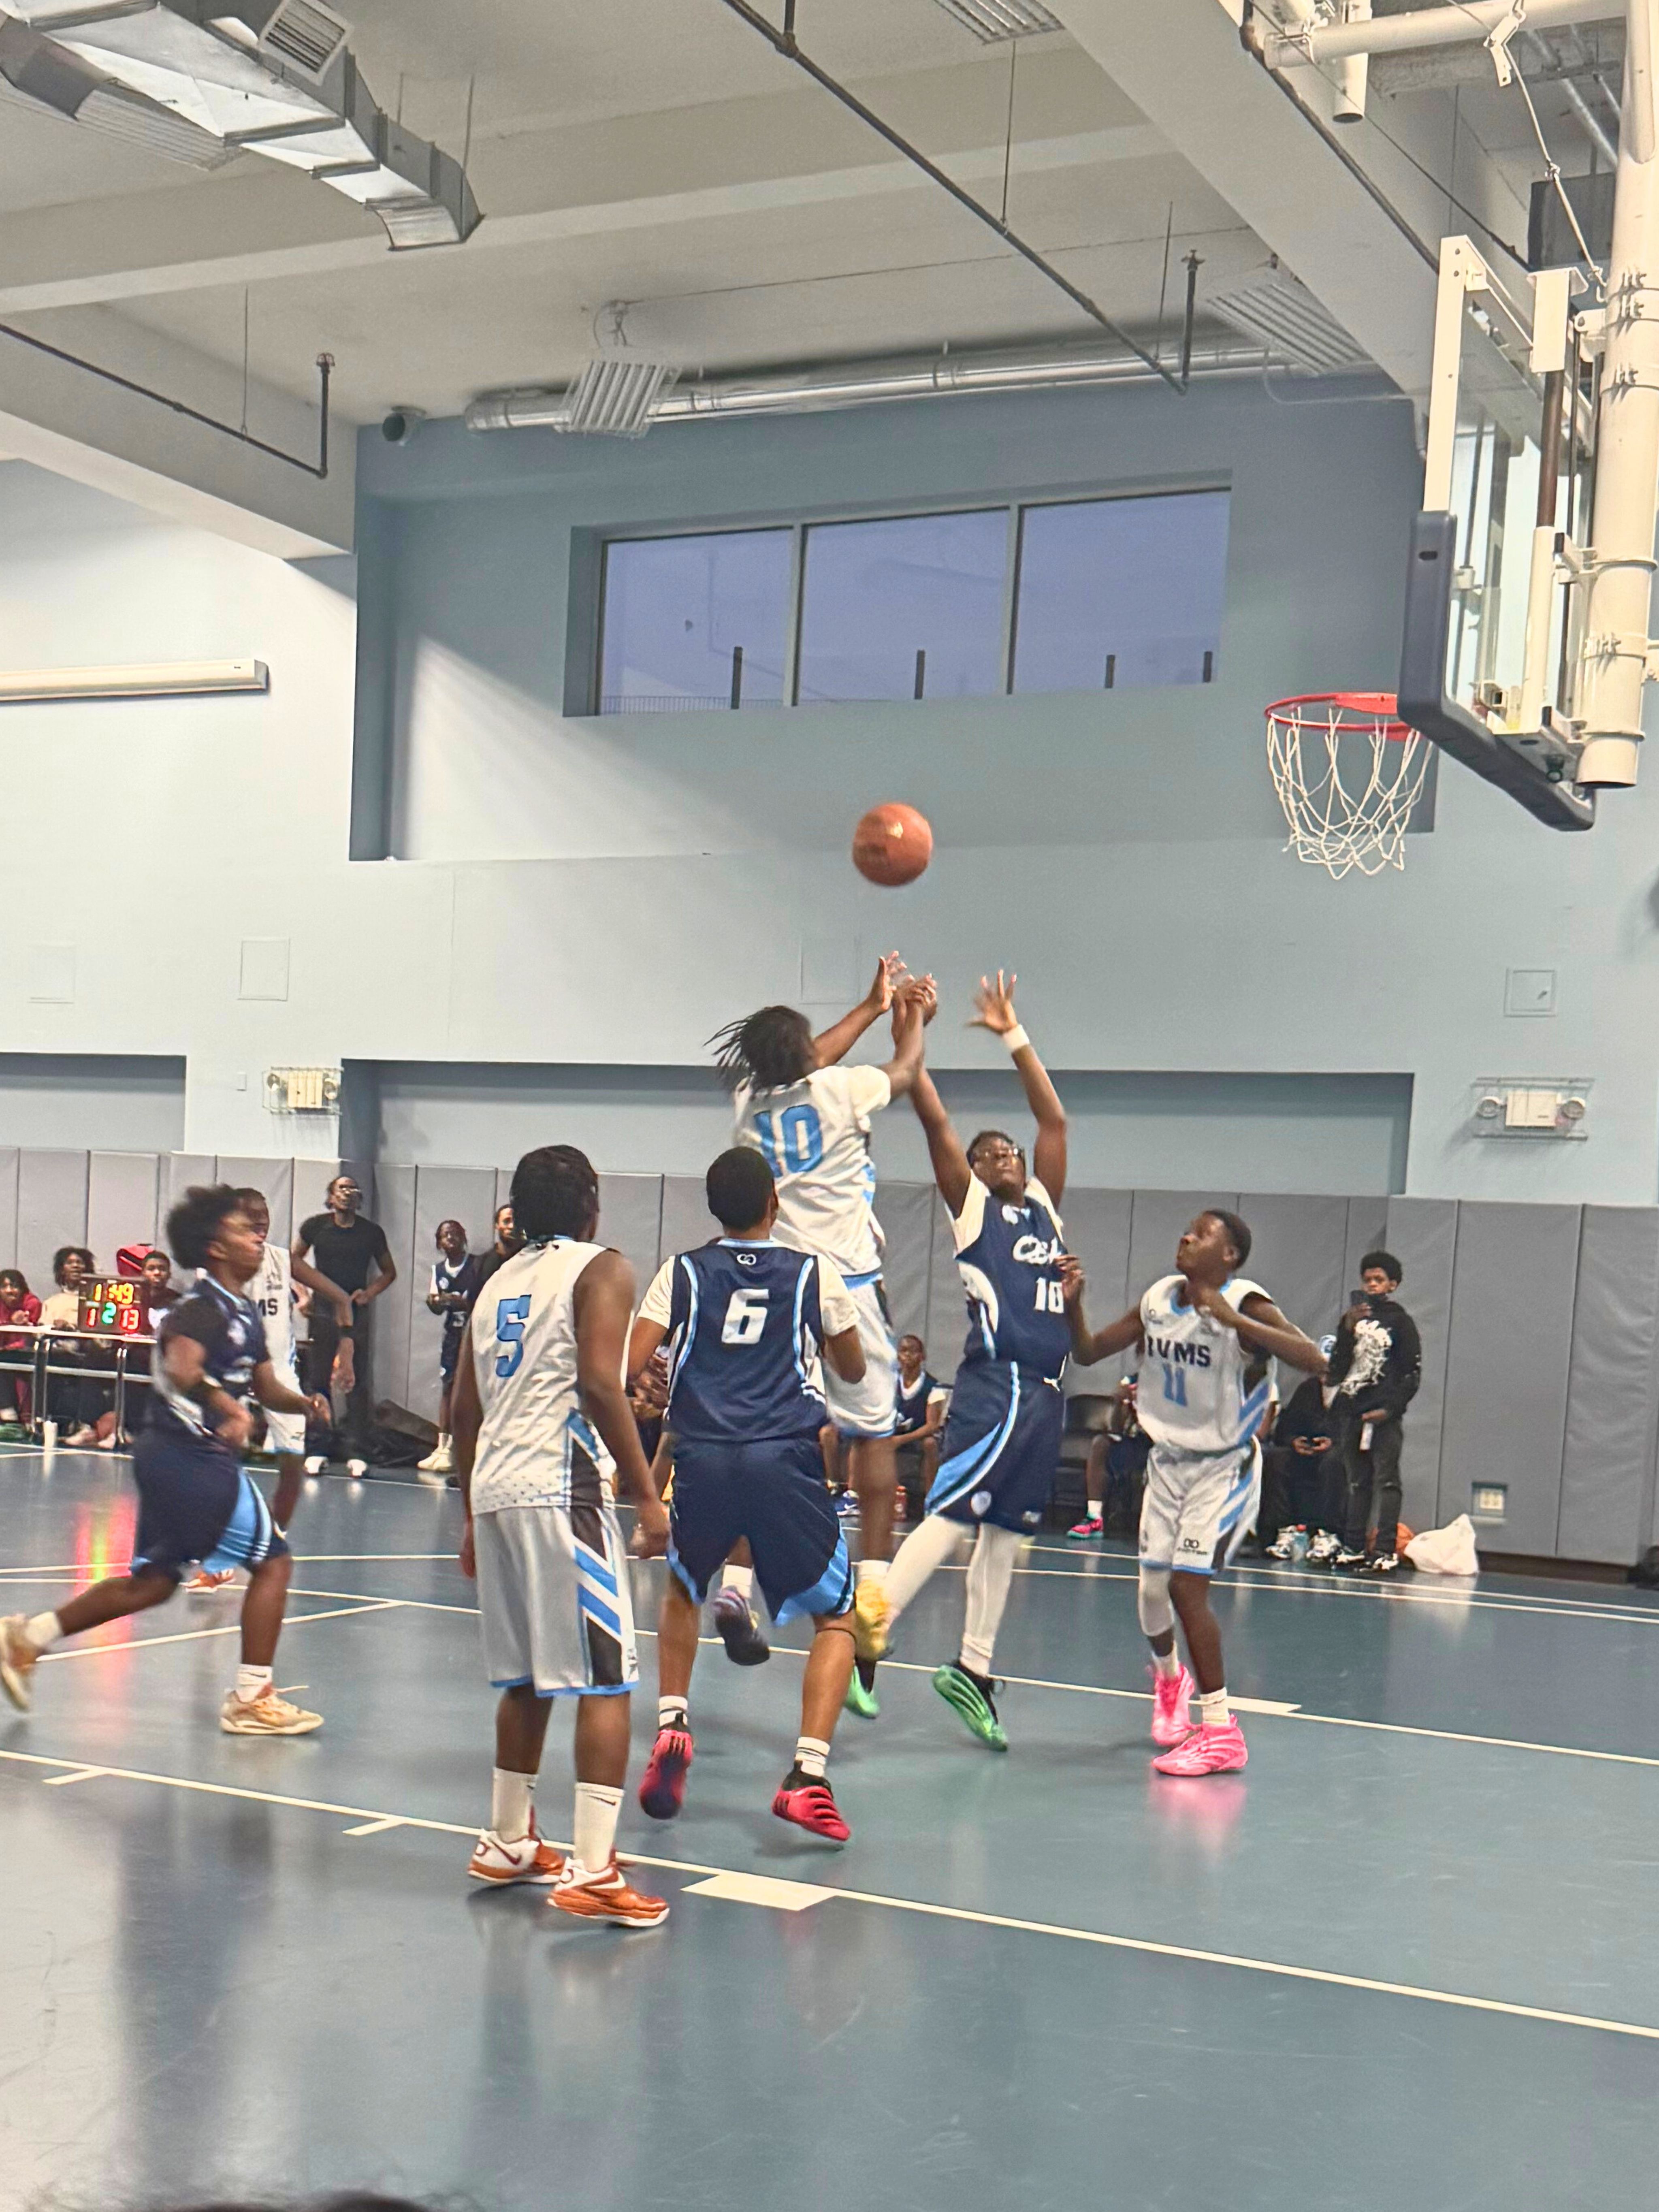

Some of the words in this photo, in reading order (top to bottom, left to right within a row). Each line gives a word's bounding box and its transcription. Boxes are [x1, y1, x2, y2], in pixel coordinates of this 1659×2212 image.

[753, 1104, 823, 1178] 10
[102, 1301, 117, 1324] 2
[121, 1308, 139, 1331] 13
[496, 1295, 531, 1377] 5
[721, 1288, 769, 1344] 6
